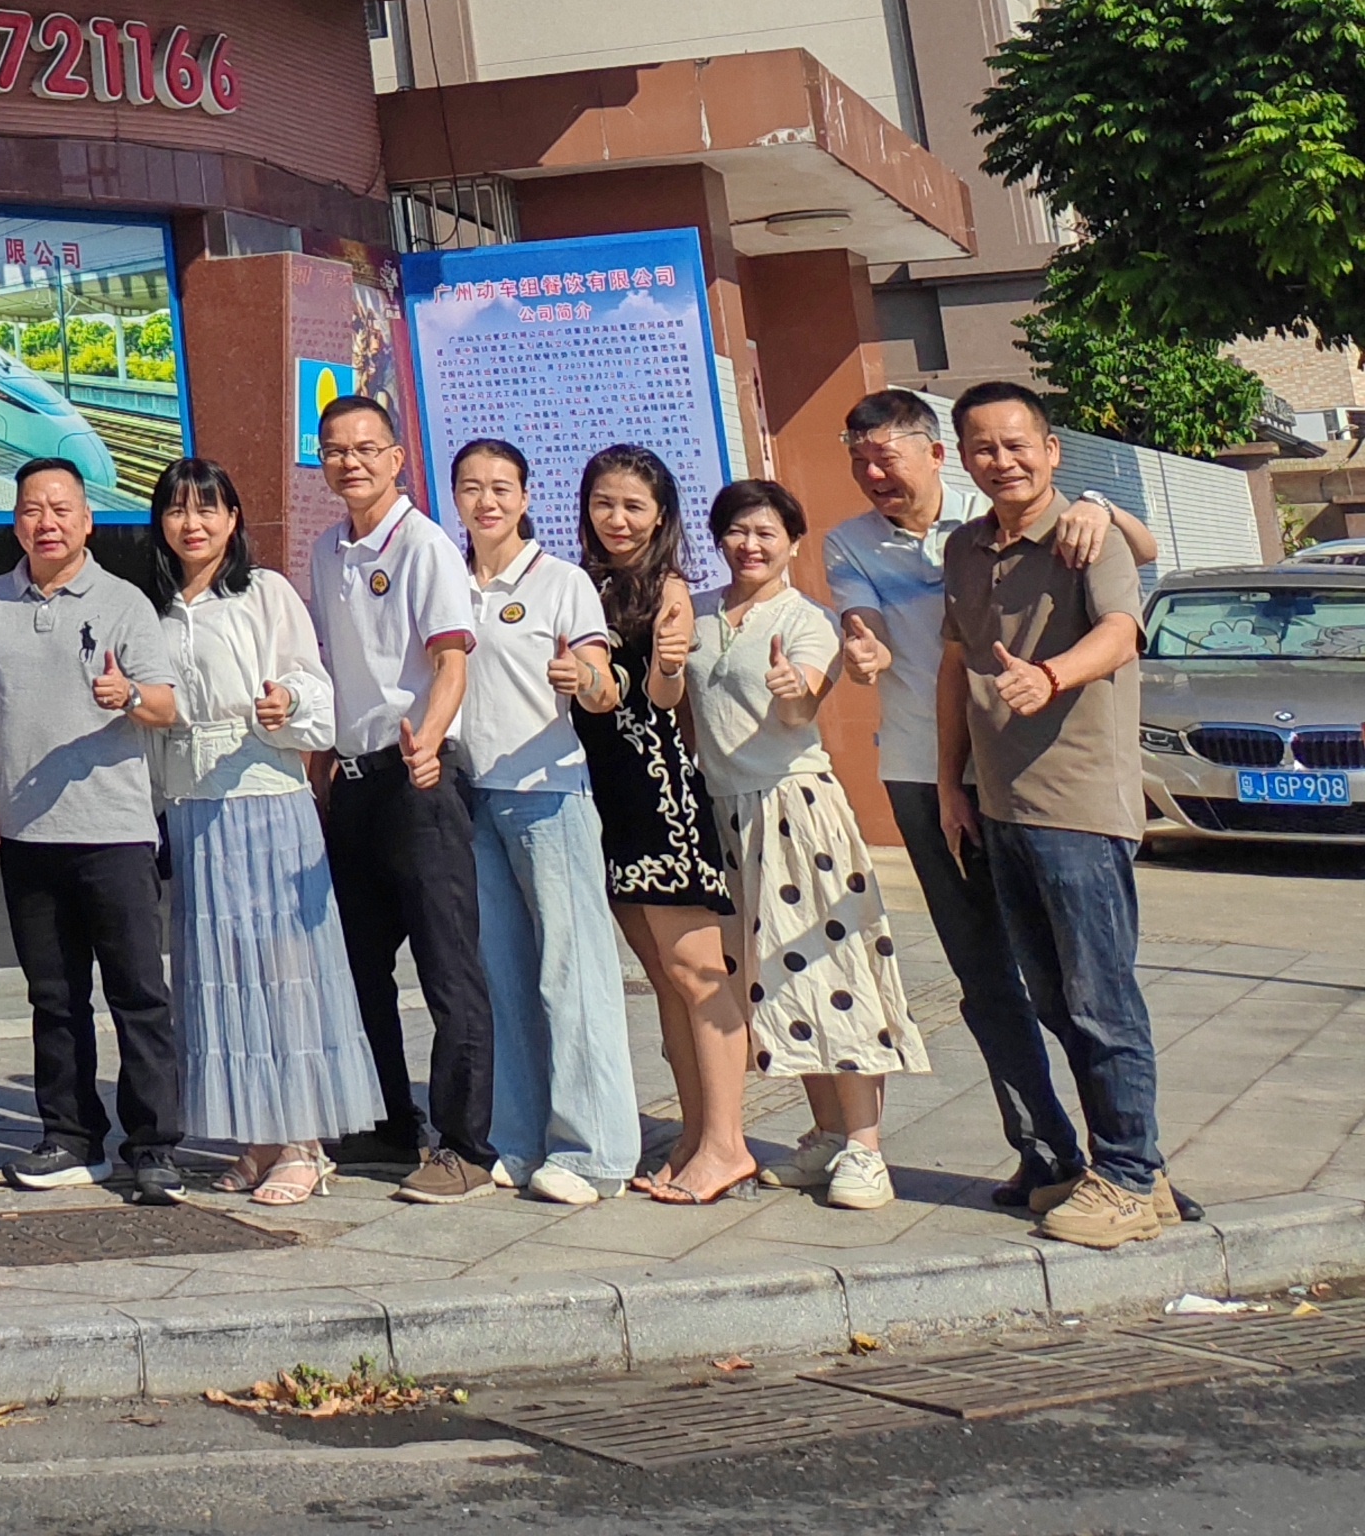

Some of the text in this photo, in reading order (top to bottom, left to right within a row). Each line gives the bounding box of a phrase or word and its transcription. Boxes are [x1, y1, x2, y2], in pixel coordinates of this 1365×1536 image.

[433, 265, 676, 304] 广州动车组餐饮有限公司
[519, 301, 592, 323] 公司简介
